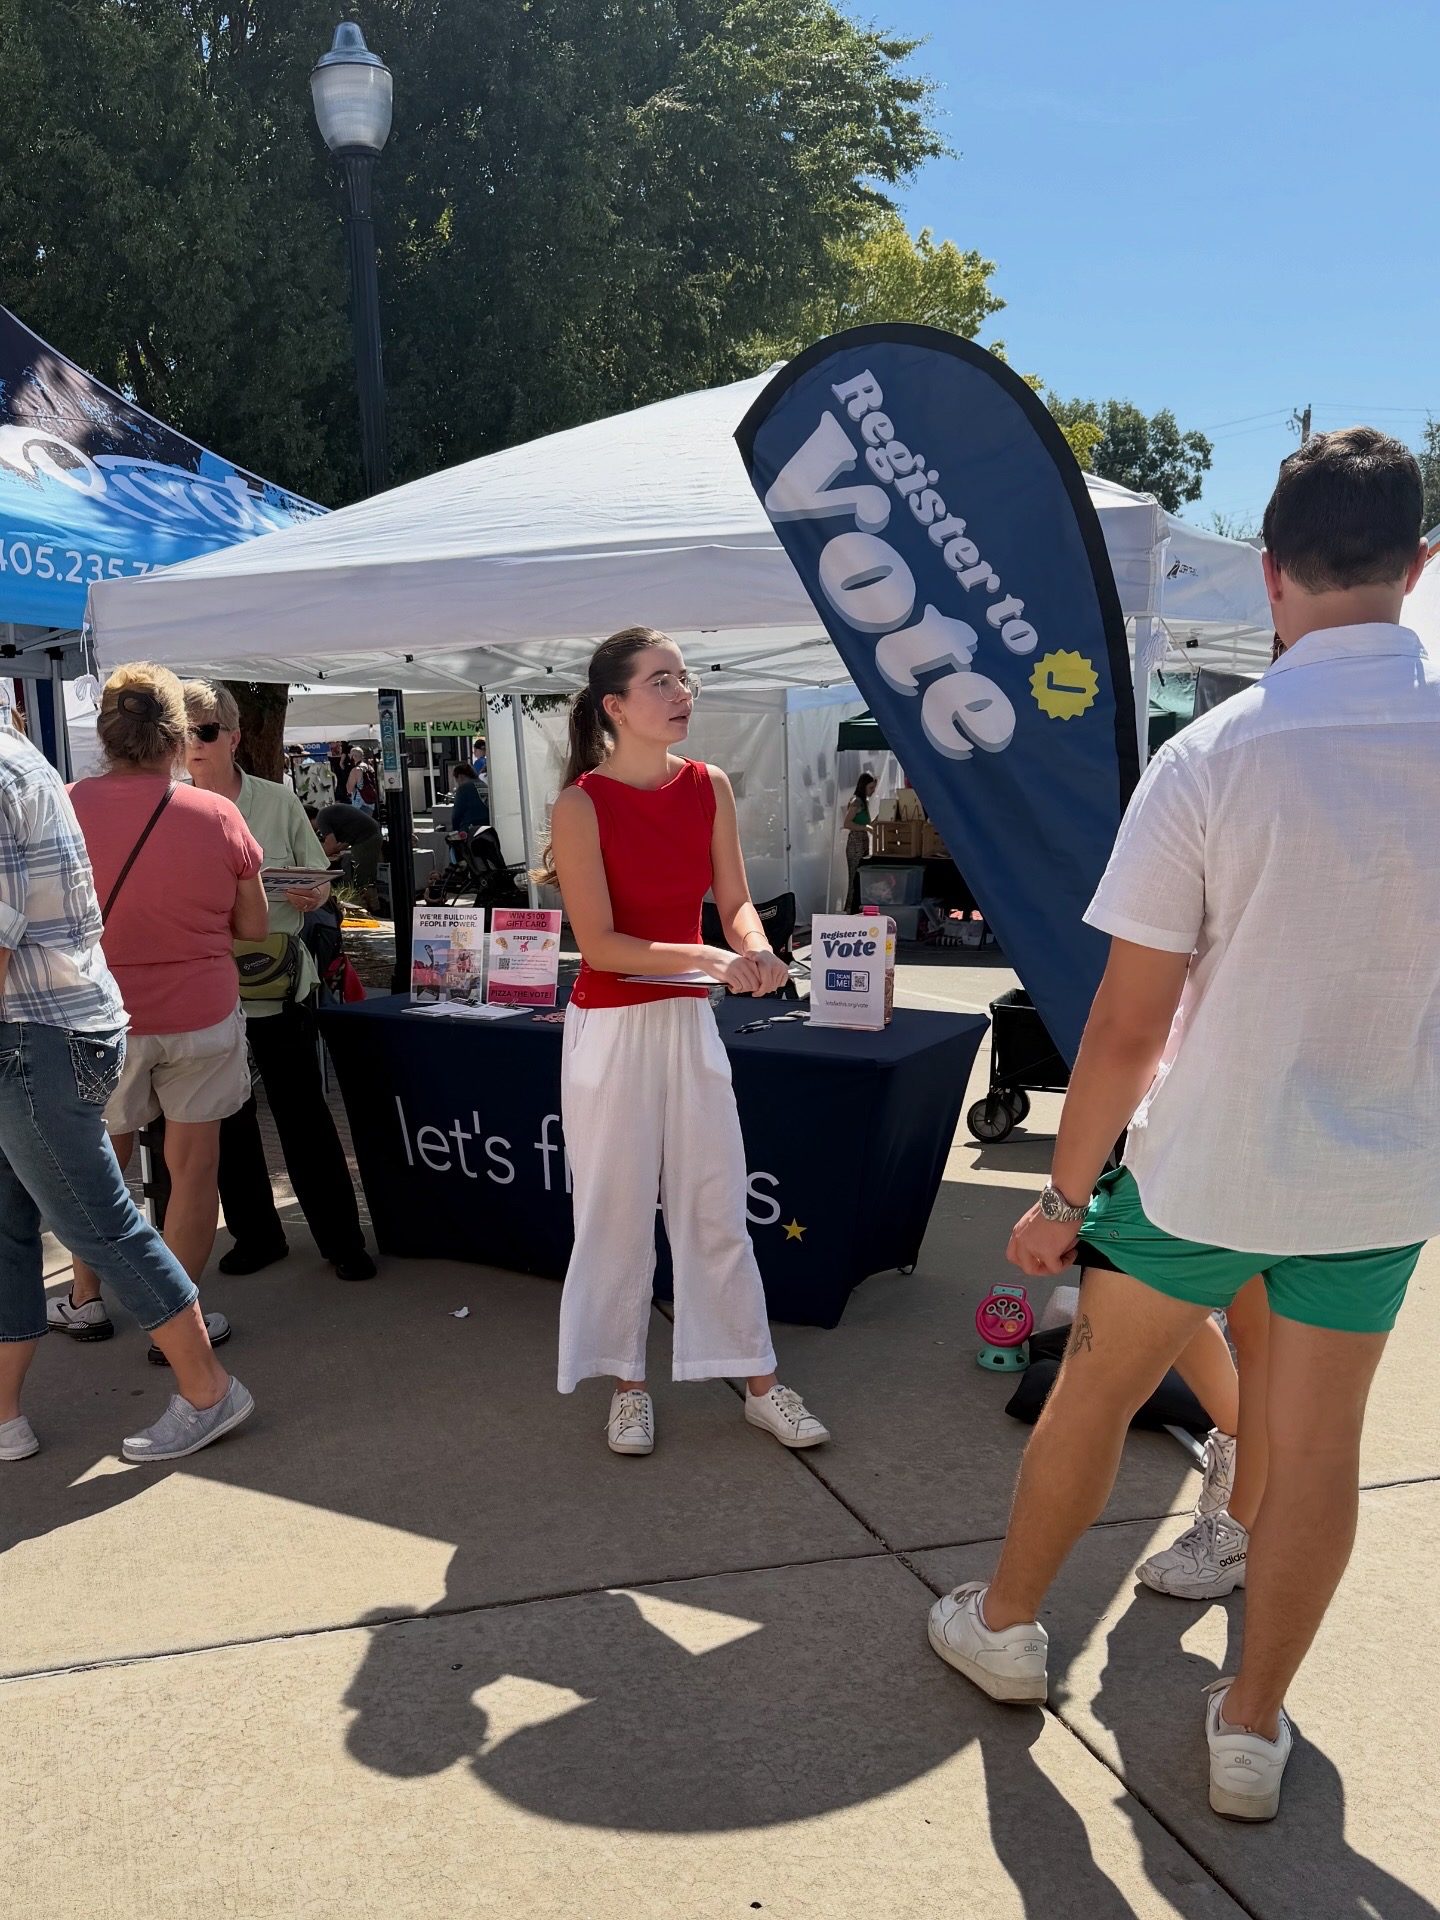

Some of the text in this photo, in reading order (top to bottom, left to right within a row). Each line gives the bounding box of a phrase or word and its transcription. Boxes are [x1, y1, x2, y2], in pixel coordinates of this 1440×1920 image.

[832, 369, 1038, 655] Register to
[765, 410, 1016, 760] Vote
[506, 920, 547, 928] GIFT CARD
[820, 929, 867, 940] Register to
[823, 939, 877, 958] Vote
[836, 979, 850, 988] ME!
[395, 1095, 574, 1194] let's fi
[1219, 1551, 1247, 1568] adida
[1024, 1641, 1038, 1652] alo
[1234, 1754, 1252, 1766] alo
